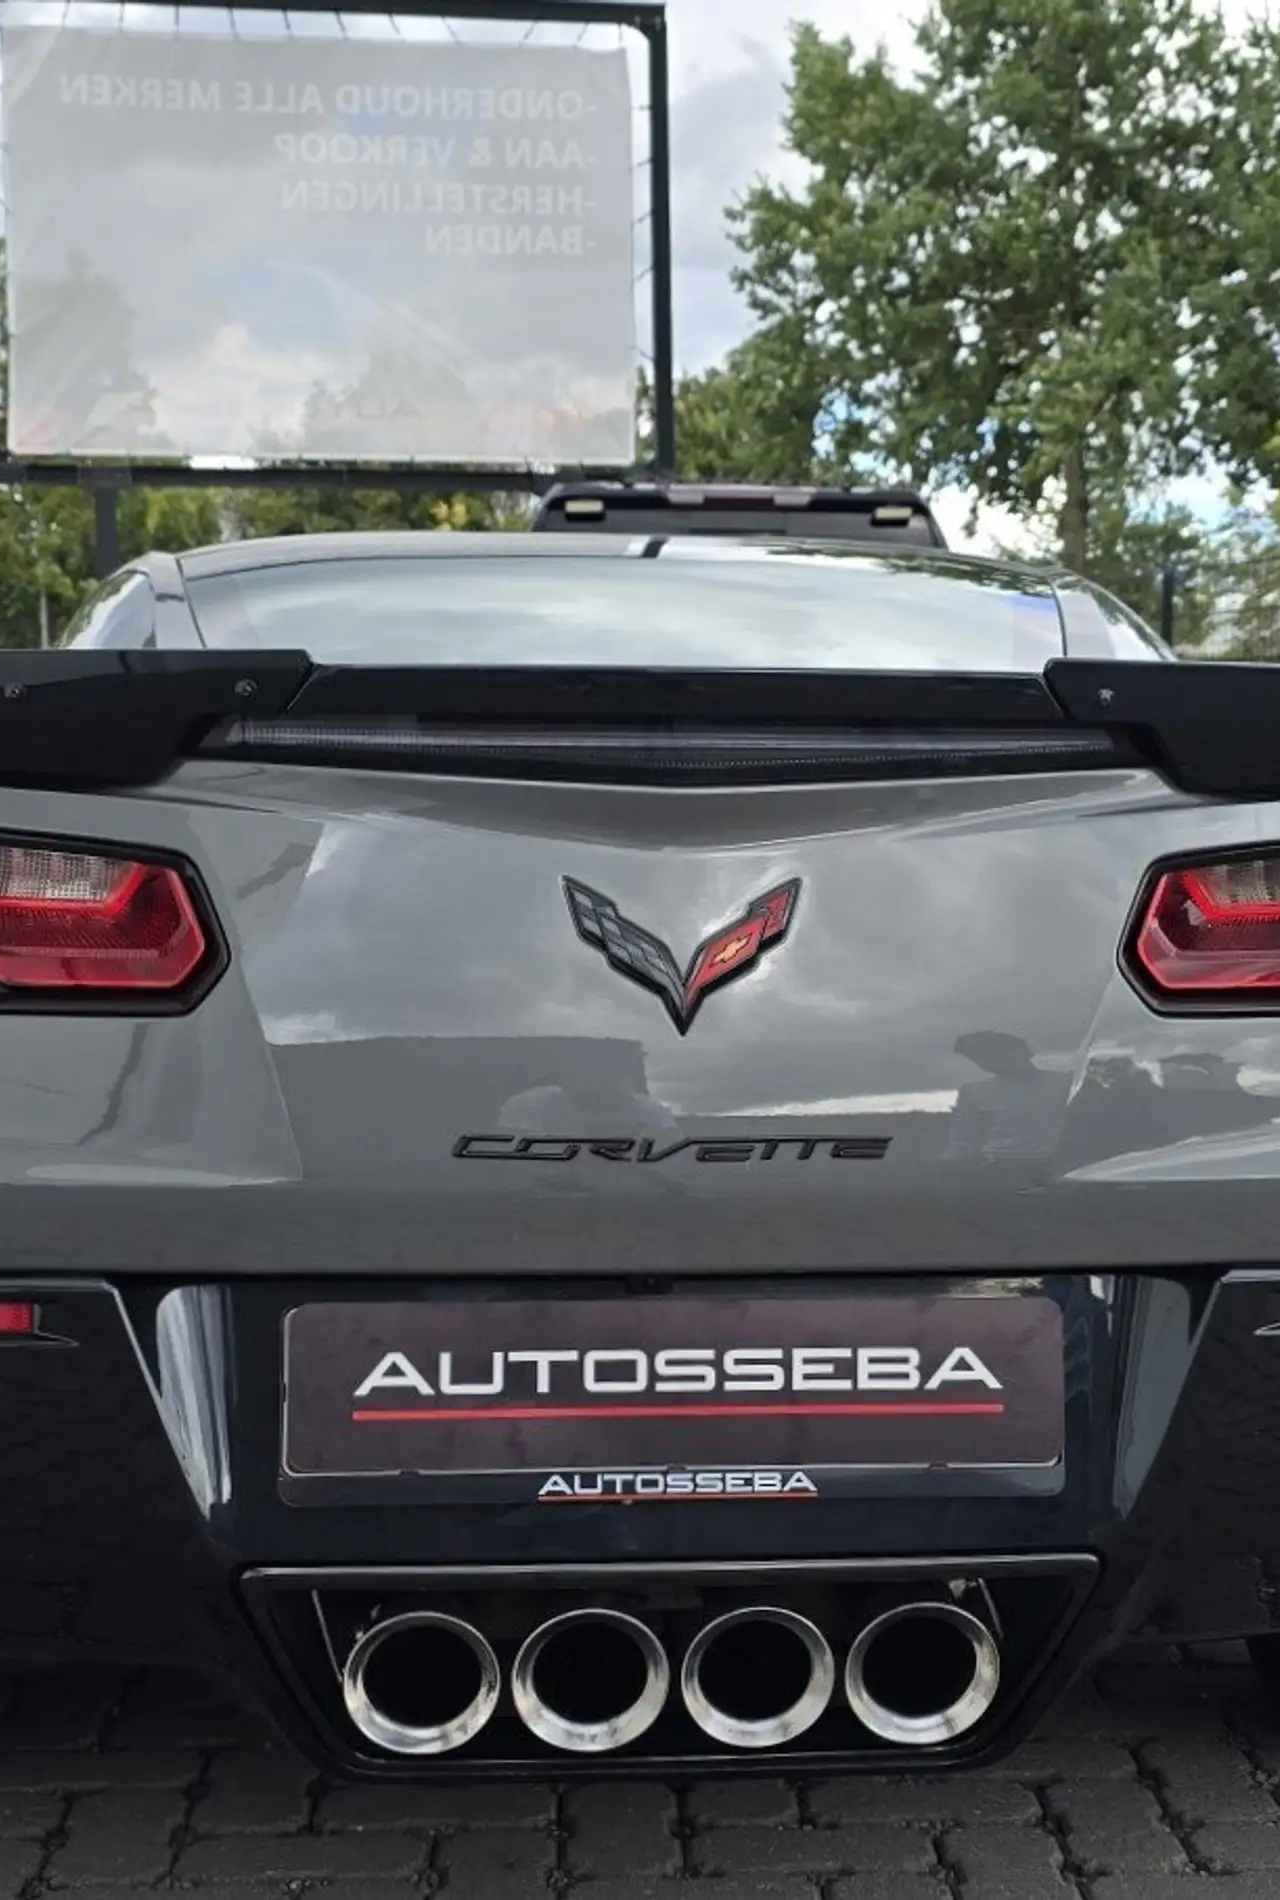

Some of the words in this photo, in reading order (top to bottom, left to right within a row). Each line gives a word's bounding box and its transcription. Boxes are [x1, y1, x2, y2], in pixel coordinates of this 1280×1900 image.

[451, 1134, 894, 1164] CORVETTE
[353, 1346, 1004, 1397] AUTOSSEBA
[538, 1471, 818, 1496] AUTOSSEBA
